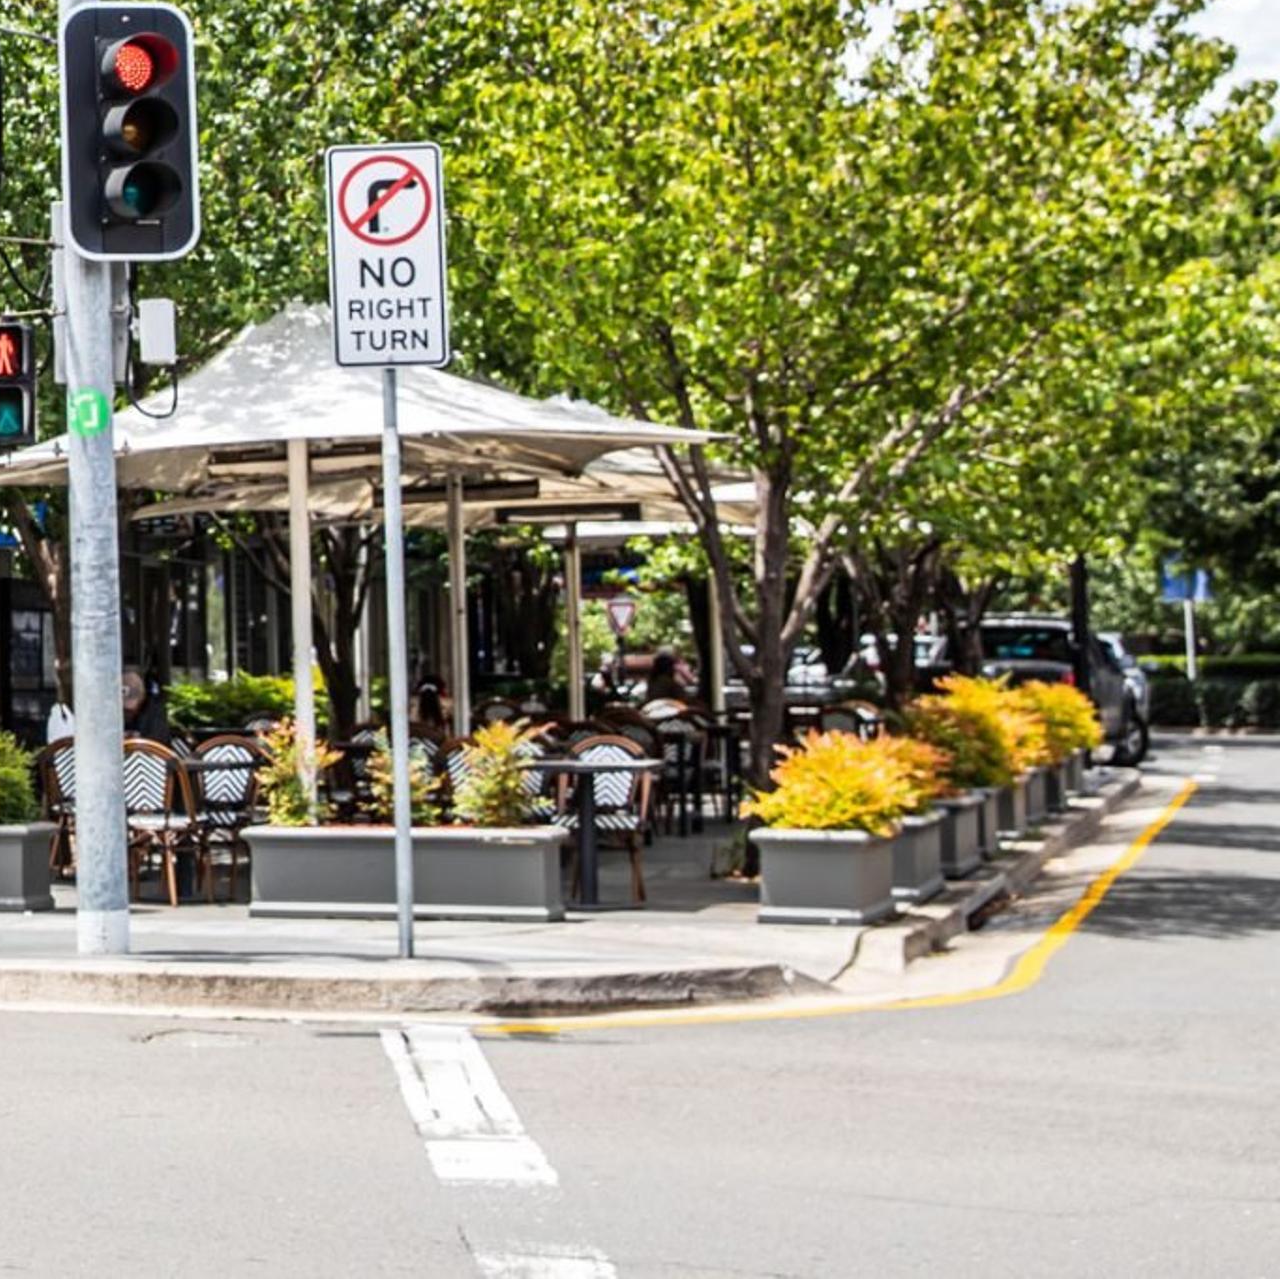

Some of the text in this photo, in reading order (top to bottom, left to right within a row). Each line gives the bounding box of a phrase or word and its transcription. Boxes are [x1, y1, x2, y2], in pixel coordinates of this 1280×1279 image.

[359, 256, 417, 288] NO
[348, 297, 433, 321] RIGHT
[351, 328, 429, 352] TURN
